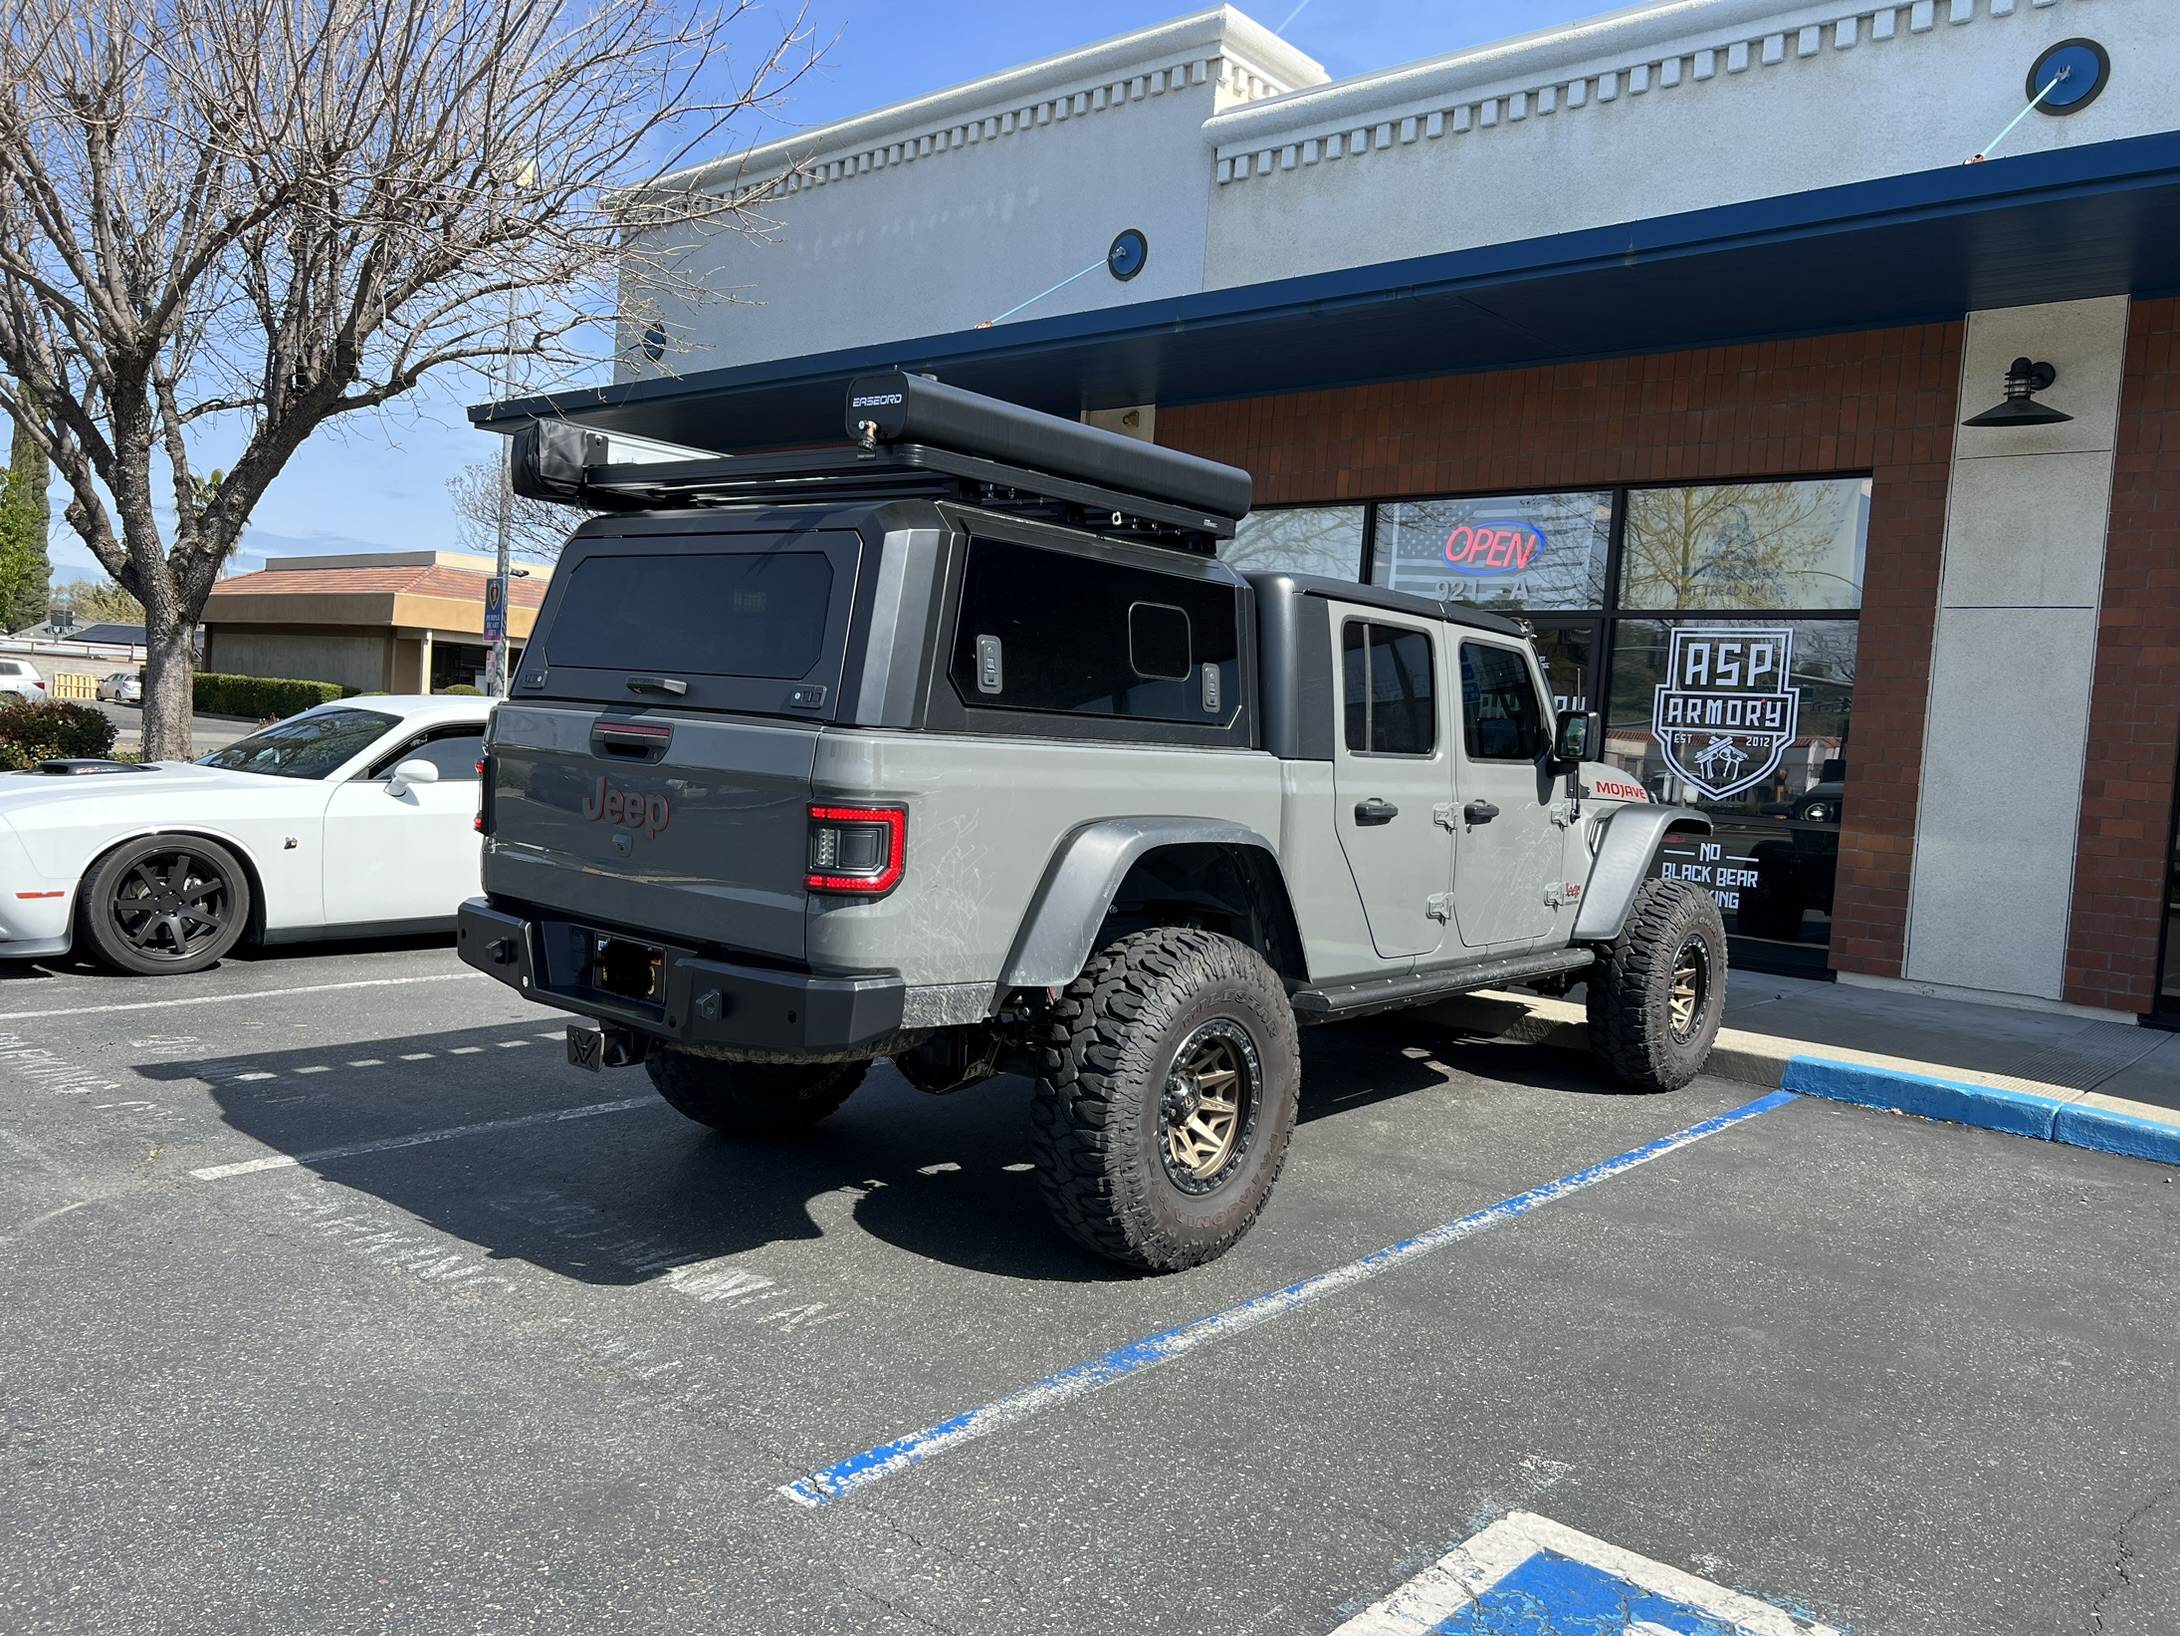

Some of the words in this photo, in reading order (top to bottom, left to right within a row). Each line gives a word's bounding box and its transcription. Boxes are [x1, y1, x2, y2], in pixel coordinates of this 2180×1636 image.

[1445, 526, 1537, 570] OPEN
[1685, 643, 1774, 686] ASP
[1667, 698, 1781, 727] ARMORY
[1674, 734, 1693, 744] EST
[1745, 737, 1770, 747] 2012
[1595, 781, 1647, 800] MOJAVE
[582, 776, 669, 840] Jeep
[1699, 842, 1721, 862] NO
[1661, 862, 1712, 883] BLACK
[1716, 867, 1758, 888] BEAR
